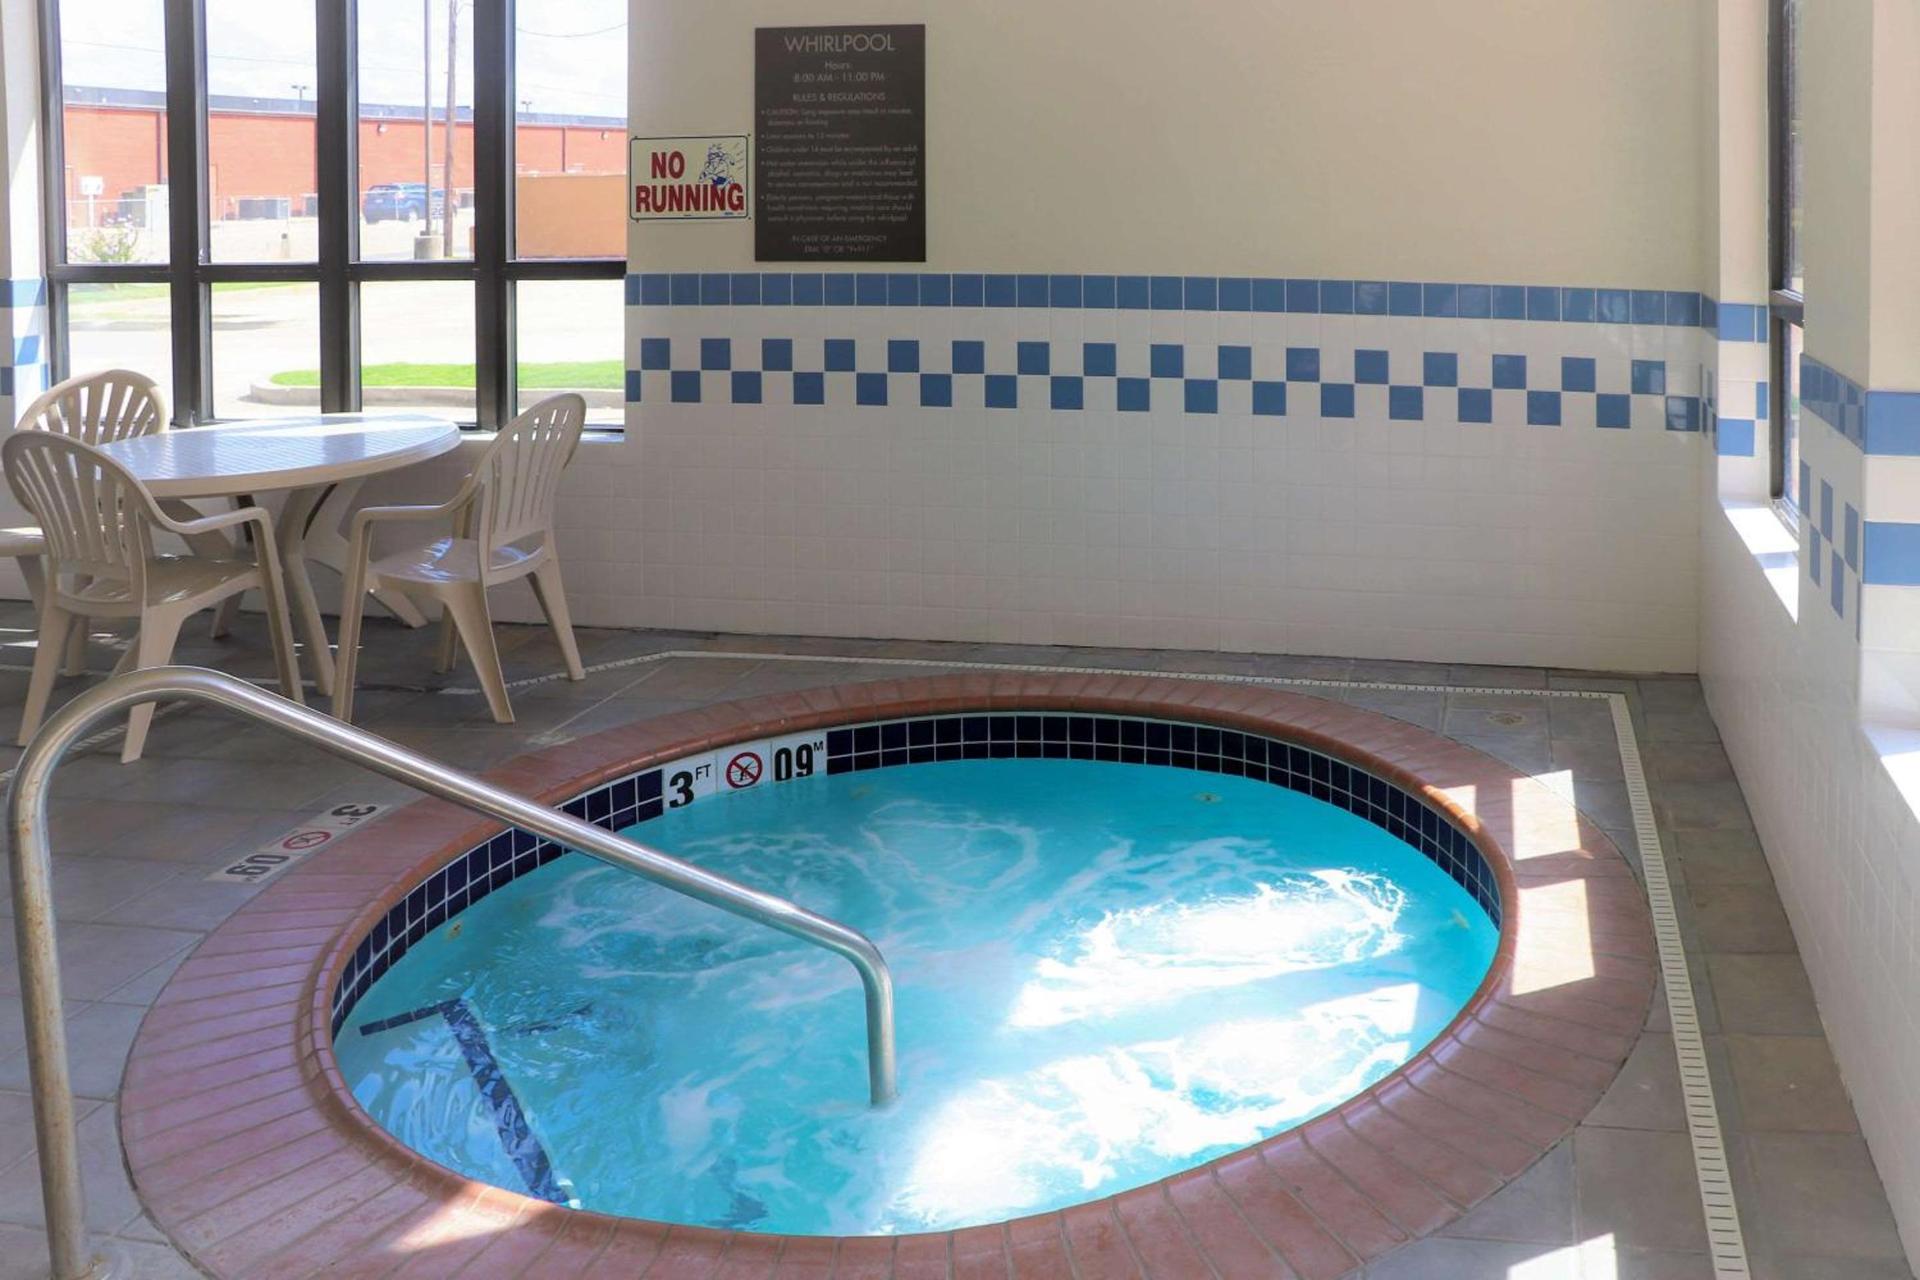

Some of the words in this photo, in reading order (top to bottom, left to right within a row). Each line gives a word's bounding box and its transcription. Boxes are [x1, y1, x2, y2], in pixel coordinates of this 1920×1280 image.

[784, 33, 897, 52] WHIRLPOOL
[816, 72, 833, 82] AM
[870, 71, 886, 81] PM
[792, 93, 817, 102] RULES
[819, 93, 826, 102] &
[827, 92, 886, 102] REGULATIONS
[651, 151, 685, 179] NO
[635, 183, 744, 212] RUNNING
[669, 771, 694, 808] 3
[695, 764, 711, 780] FT
